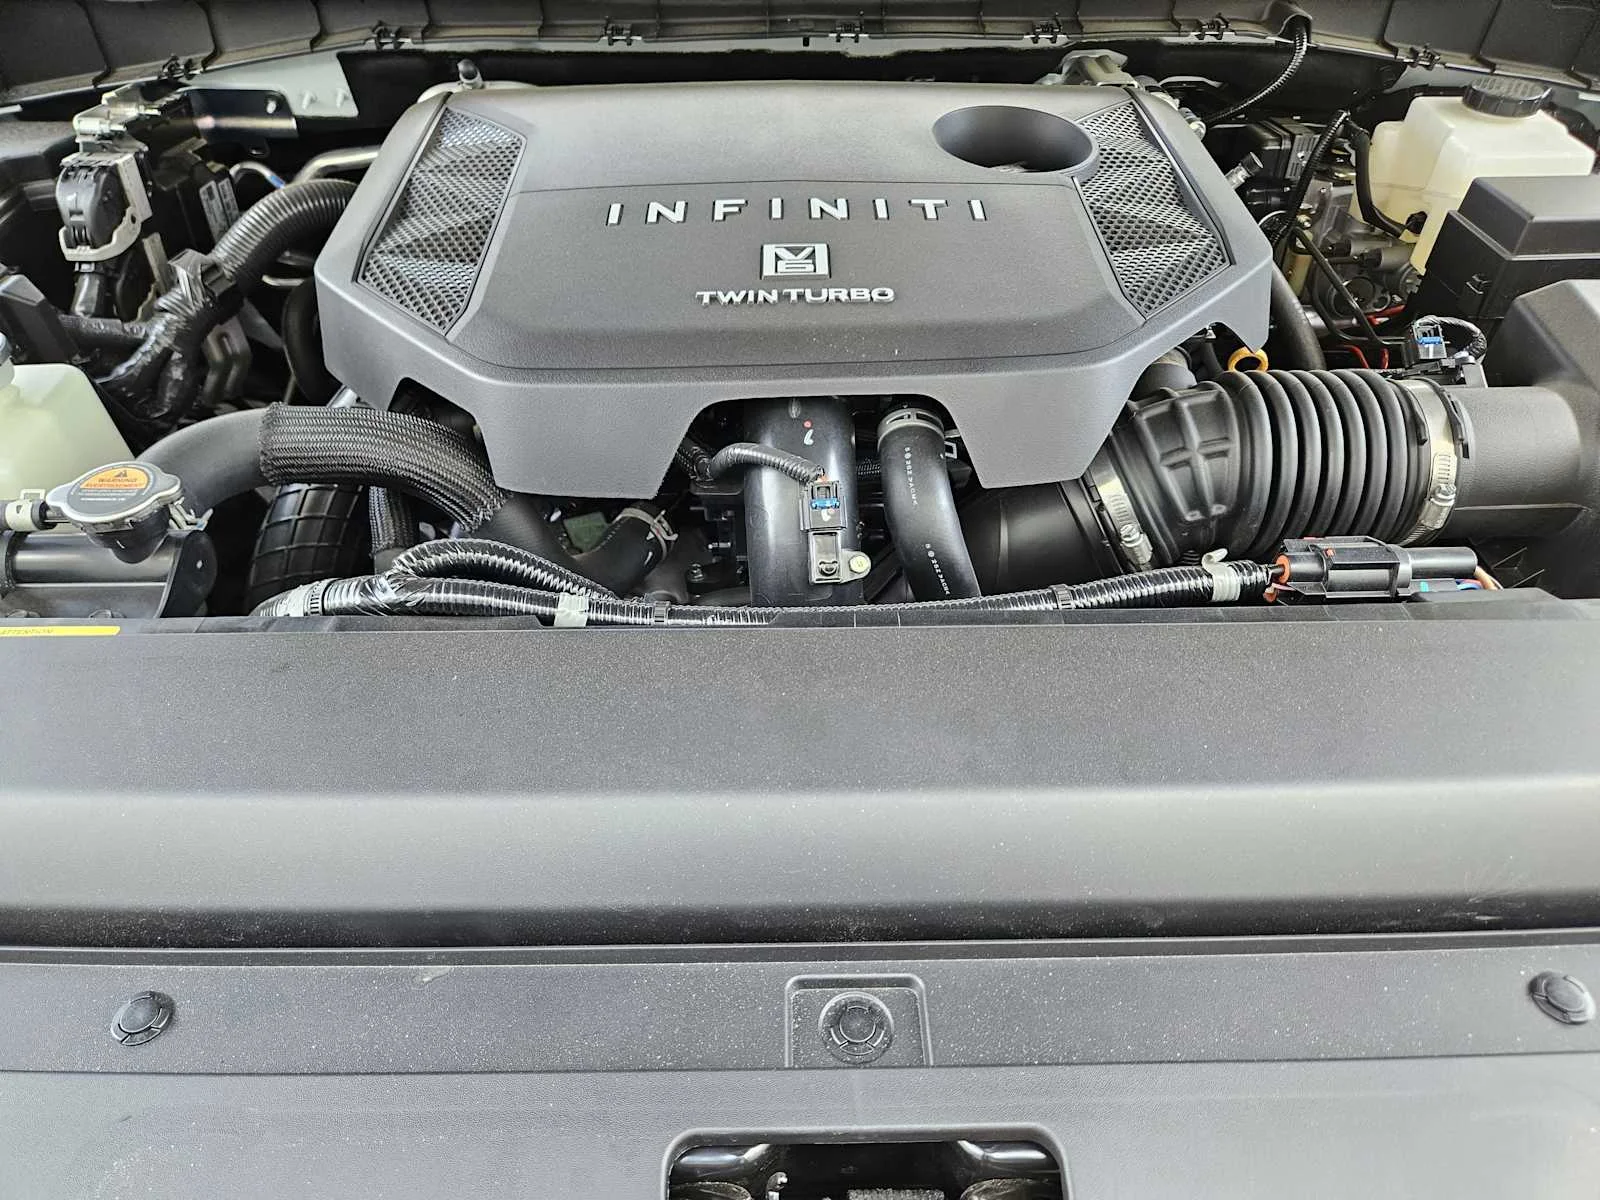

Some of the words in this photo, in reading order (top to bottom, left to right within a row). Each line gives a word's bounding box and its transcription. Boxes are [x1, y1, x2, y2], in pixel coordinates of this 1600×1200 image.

[606, 197, 989, 226] INFINITI
[696, 289, 779, 306] TWIN
[783, 286, 896, 304] TURBO
